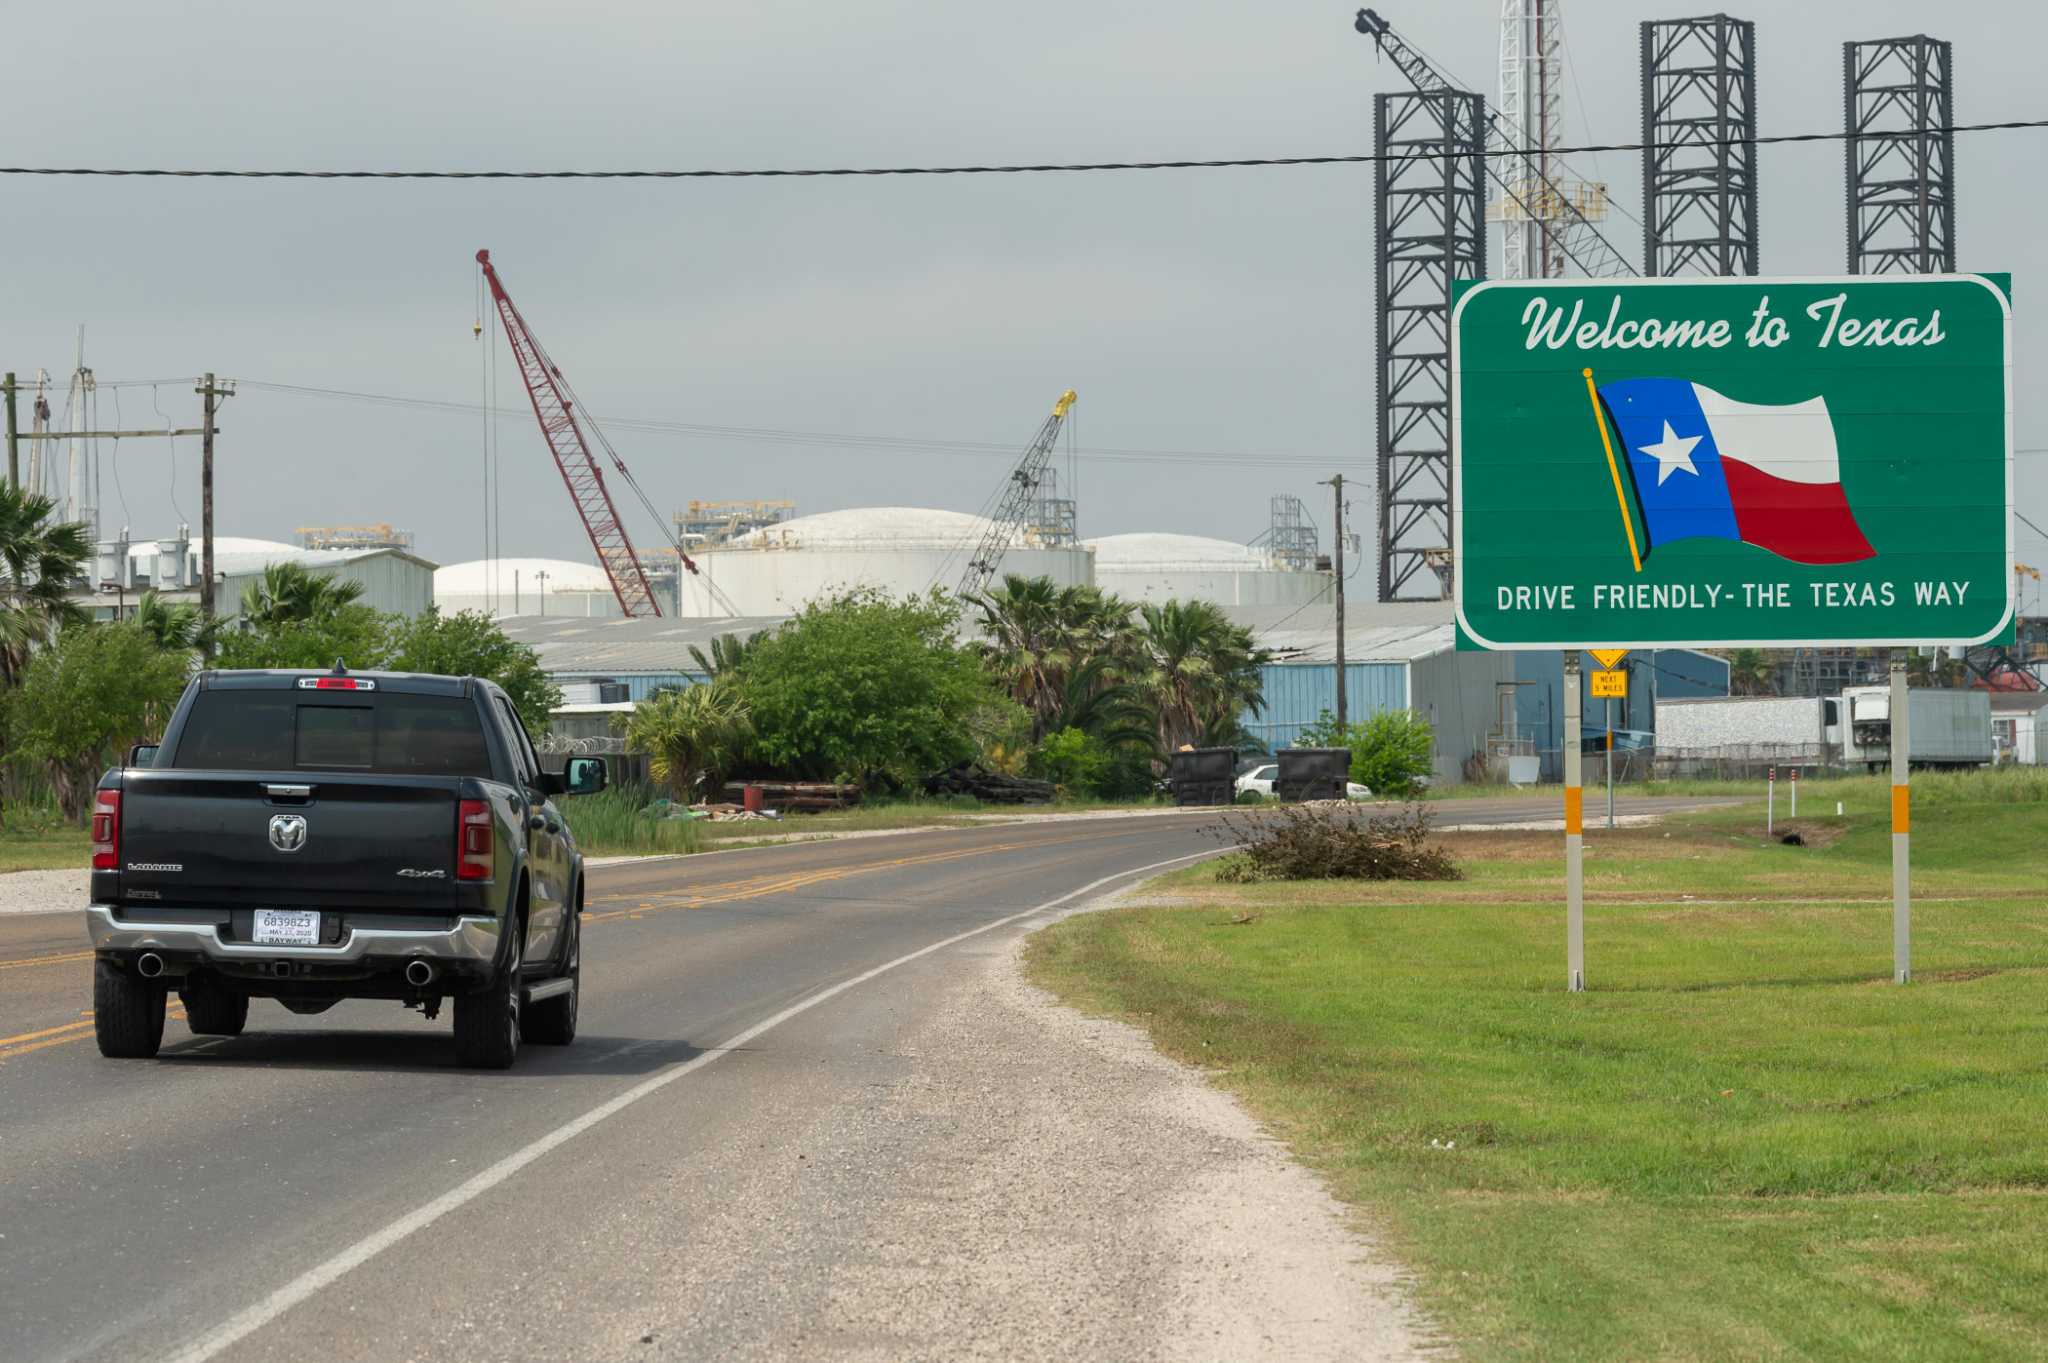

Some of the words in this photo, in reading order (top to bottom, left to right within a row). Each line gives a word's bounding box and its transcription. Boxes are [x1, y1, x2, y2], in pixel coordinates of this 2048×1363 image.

[1521, 294, 1732, 350] Welcome
[1745, 295, 1790, 348] to
[1806, 292, 1946, 348] Texas
[1497, 585, 1575, 610] DRIVE
[1809, 582, 1895, 607] TEXAS
[1914, 581, 1969, 606] WAY
[397, 868, 447, 879] 4x4
